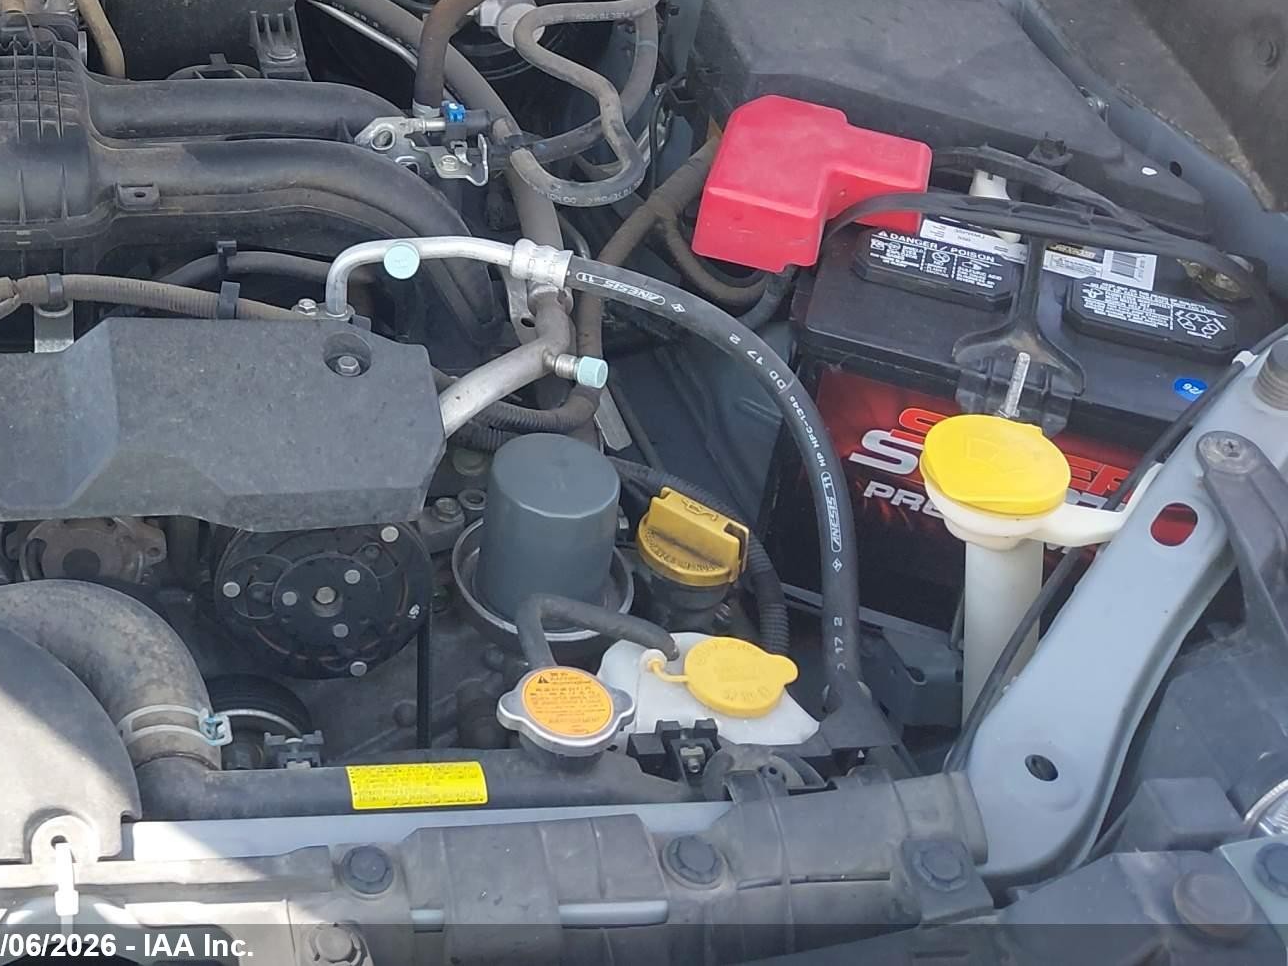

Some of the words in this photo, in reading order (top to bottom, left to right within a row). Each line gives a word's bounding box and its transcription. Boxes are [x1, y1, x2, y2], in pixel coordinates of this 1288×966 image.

[890, 233, 938, 251] DANGER
[950, 247, 995, 263] POISON
[728, 333, 741, 345] 2
[746, 350, 764, 366] 17
[769, 370, 787, 390] DD
[816, 452, 827, 467] HP
[834, 616, 843, 627] 2
